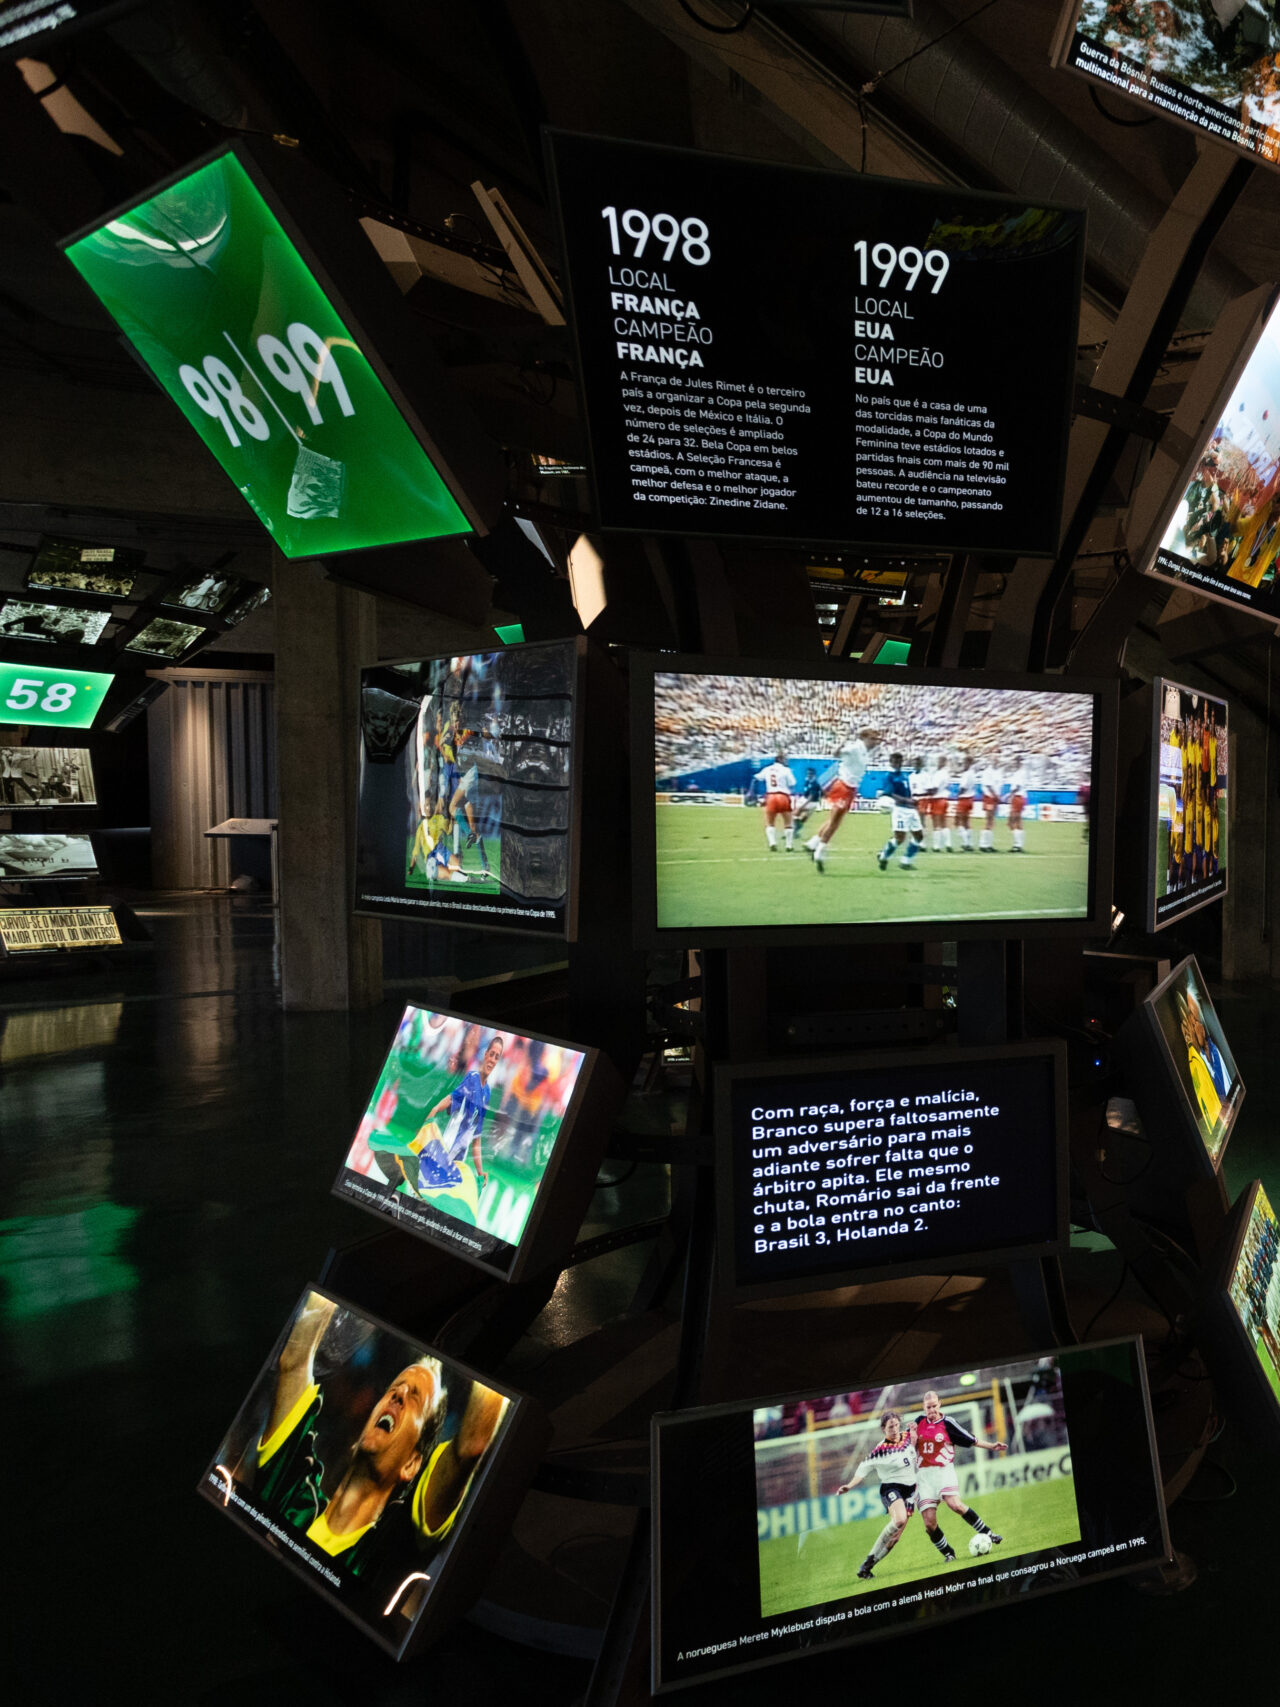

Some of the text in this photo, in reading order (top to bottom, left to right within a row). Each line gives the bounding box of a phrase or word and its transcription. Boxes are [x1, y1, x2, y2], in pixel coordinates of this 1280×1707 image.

[1080, 43, 1108, 63] Guerra
[1109, 58, 1119, 69] da
[1120, 63, 1148, 83] Bósnia.
[1150, 77, 1176, 96] Russos
[1183, 95, 1244, 130] norte-americanos
[1075, 57, 1272, 157] multinacional para a manutenção da paz na Bósnia, 1996.
[601, 206, 711, 266] 1998
[609, 267, 675, 292] LOCAL
[854, 240, 950, 294] 1999
[611, 292, 700, 321] FRANÇA
[855, 297, 913, 319] LOCAL
[614, 317, 712, 344] CAMPEÃO
[855, 320, 894, 340] EUA
[617, 342, 704, 369] FRANÇA
[855, 344, 944, 368] CAMPEÃO
[621, 371, 628, 380] A
[631, 372, 666, 385] França
[670, 377, 682, 386] de
[686, 378, 713, 389] Jules
[716, 381, 745, 392] Rimet
[749, 384, 754, 393] é
[766, 387, 805, 397] terceiro
[855, 367, 894, 386] EUA
[622, 388, 643, 397] país
[656, 392, 704, 403] organizar
[717, 396, 742, 407] Copa
[745, 401, 766, 409] pela
[769, 403, 810, 413] segunda
[856, 394, 869, 403] No
[871, 396, 891, 405] país
[893, 399, 911, 408] que
[913, 399, 919, 408] é
[930, 402, 951, 410] casa
[953, 403, 965, 412] de
[967, 406, 987, 414] uma
[855, 409, 995, 428] das torcidas mais fanáticas da
[6, 679, 77, 712] 58
[32, 929, 68, 943] FUTEBOL
[751, 1089, 979, 1121] Com raça, força e malícia,
[752, 1106, 999, 1140] Branco supera faltosamente
[752, 1125, 971, 1159] um adversário para mais
[752, 1144, 973, 1178] adiante sofrer falta que o
[753, 1162, 970, 1196] árbitro apita. Ele mesmo
[753, 1175, 1000, 1215] chuta, Romário sai da frente
[754, 1199, 960, 1234] e a bola entra no canto:
[755, 1218, 928, 1253] Brasil 3, Holanda 2.
[903, 1457, 910, 1467] 9
[923, 1442, 934, 1454] 13
[678, 1652, 683, 1660] A
[686, 1640, 737, 1658] norueguesa
[739, 1632, 769, 1645] Merete
[771, 1620, 814, 1637] Myklebust
[815, 1613, 846, 1626] disputa
[854, 1606, 872, 1616] bola
[873, 1602, 890, 1611] com
[898, 1592, 923, 1605] alemã
[924, 1587, 944, 1599] Heidi
[945, 1582, 965, 1593] Mohr
[967, 1580, 977, 1588] na
[977, 1574, 994, 1585] final
[995, 1572, 1009, 1582] que
[1010, 1563, 1049, 1577] consagrou
[1056, 1553, 1087, 1566] Noruega
[1087, 1544, 1115, 1558] campeã
[1116, 1543, 1127, 1551] em
[1129, 1536, 1147, 1547] 1995.
